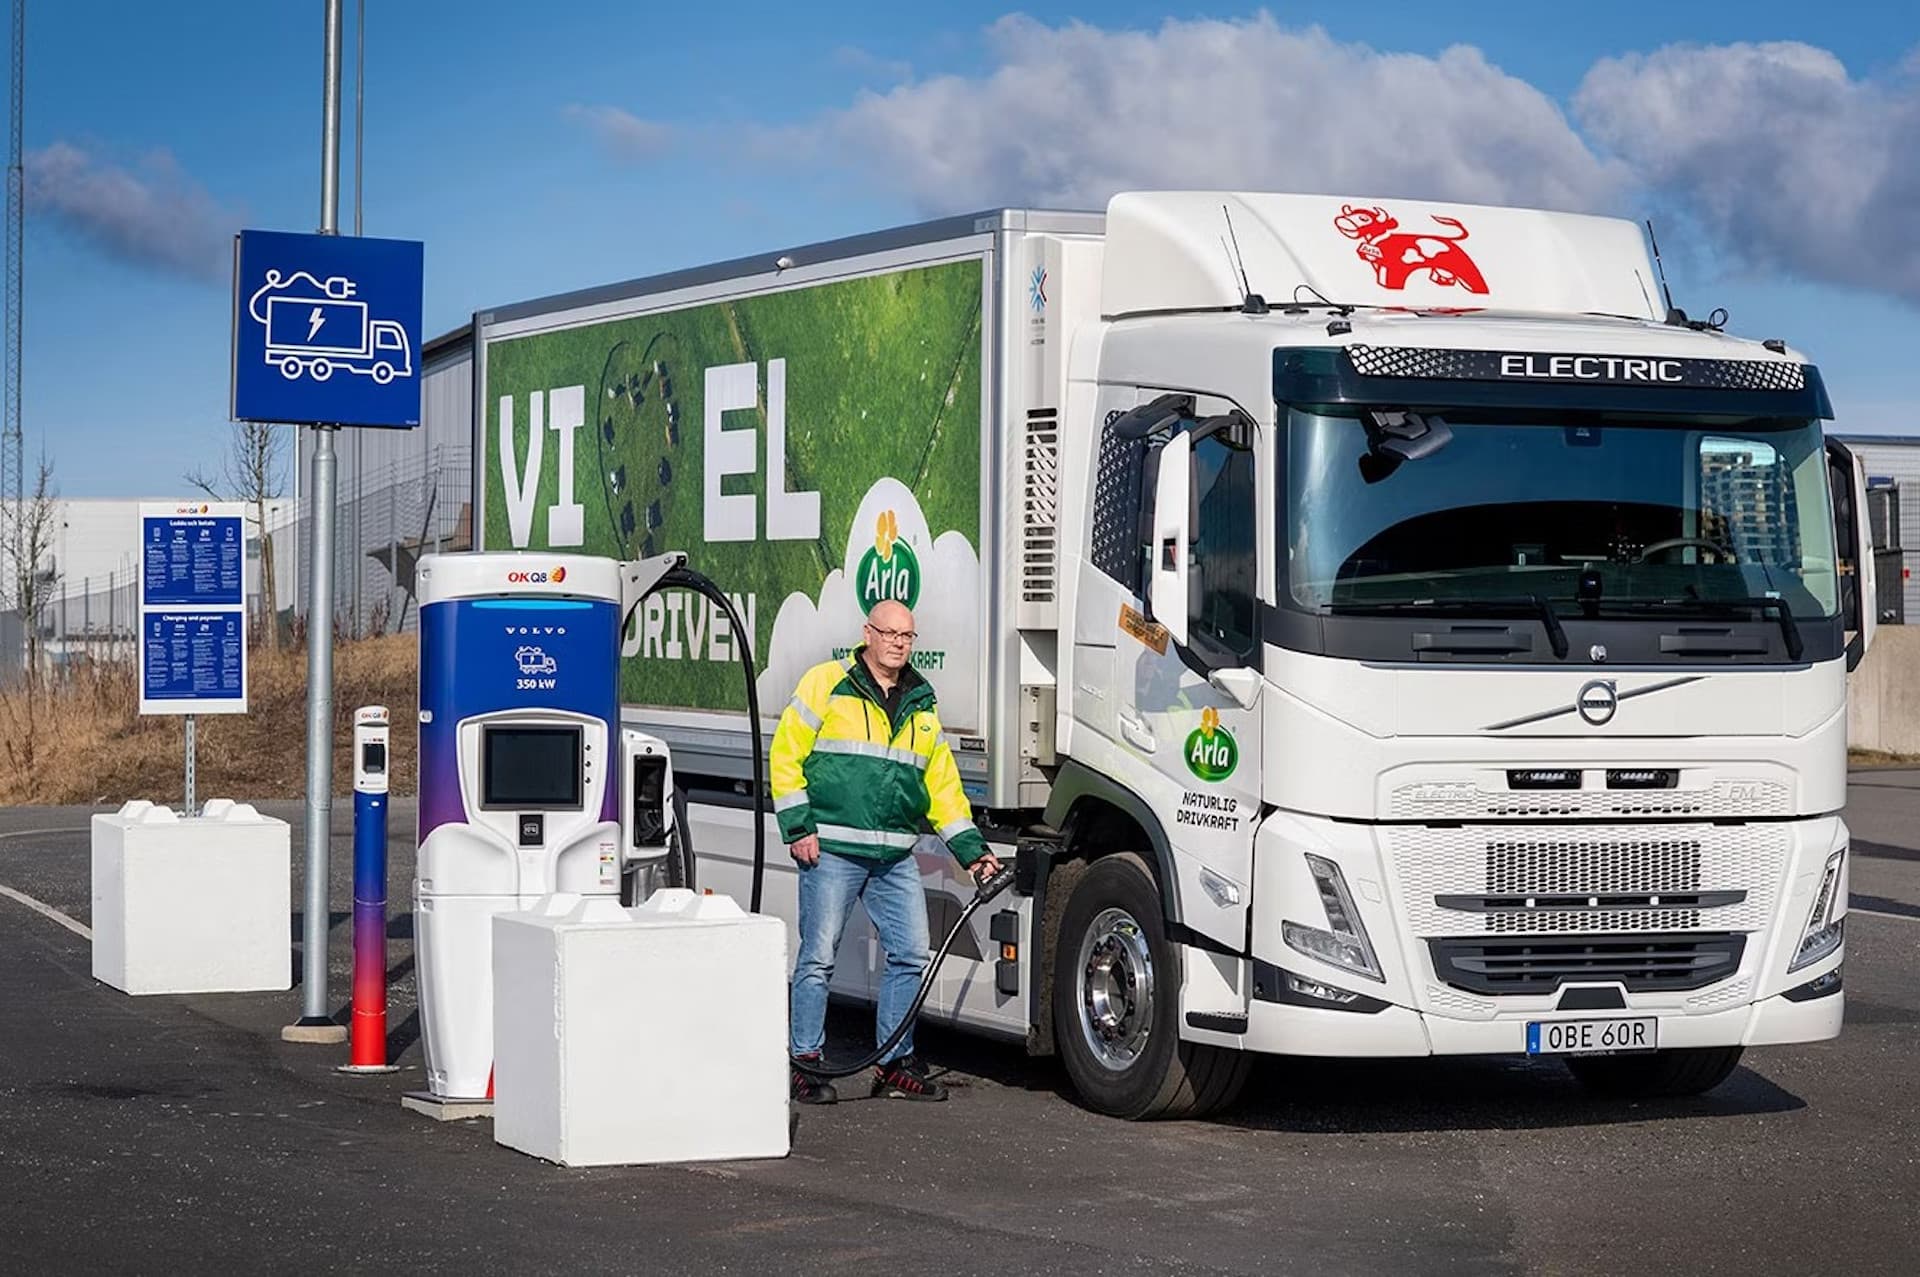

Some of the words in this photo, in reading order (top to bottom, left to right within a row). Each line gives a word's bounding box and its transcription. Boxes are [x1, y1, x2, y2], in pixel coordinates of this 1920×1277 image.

[1501, 355, 1682, 382] ELECTRIC
[500, 385, 584, 548] VI
[704, 358, 820, 541] EL
[865, 554, 910, 600] Arla
[505, 627, 566, 635] VOLVO
[621, 592, 756, 662] DRIVEN
[911, 650, 945, 670] KRAFT
[516, 679, 536, 690] 350
[538, 679, 556, 689] kW
[1191, 735, 1229, 768] Arla
[1182, 792, 1238, 813] NATURLIG
[1176, 809, 1239, 832] DRIVKRAFT
[1548, 1025, 1593, 1049] OBE
[1601, 1023, 1646, 1047] 60R
